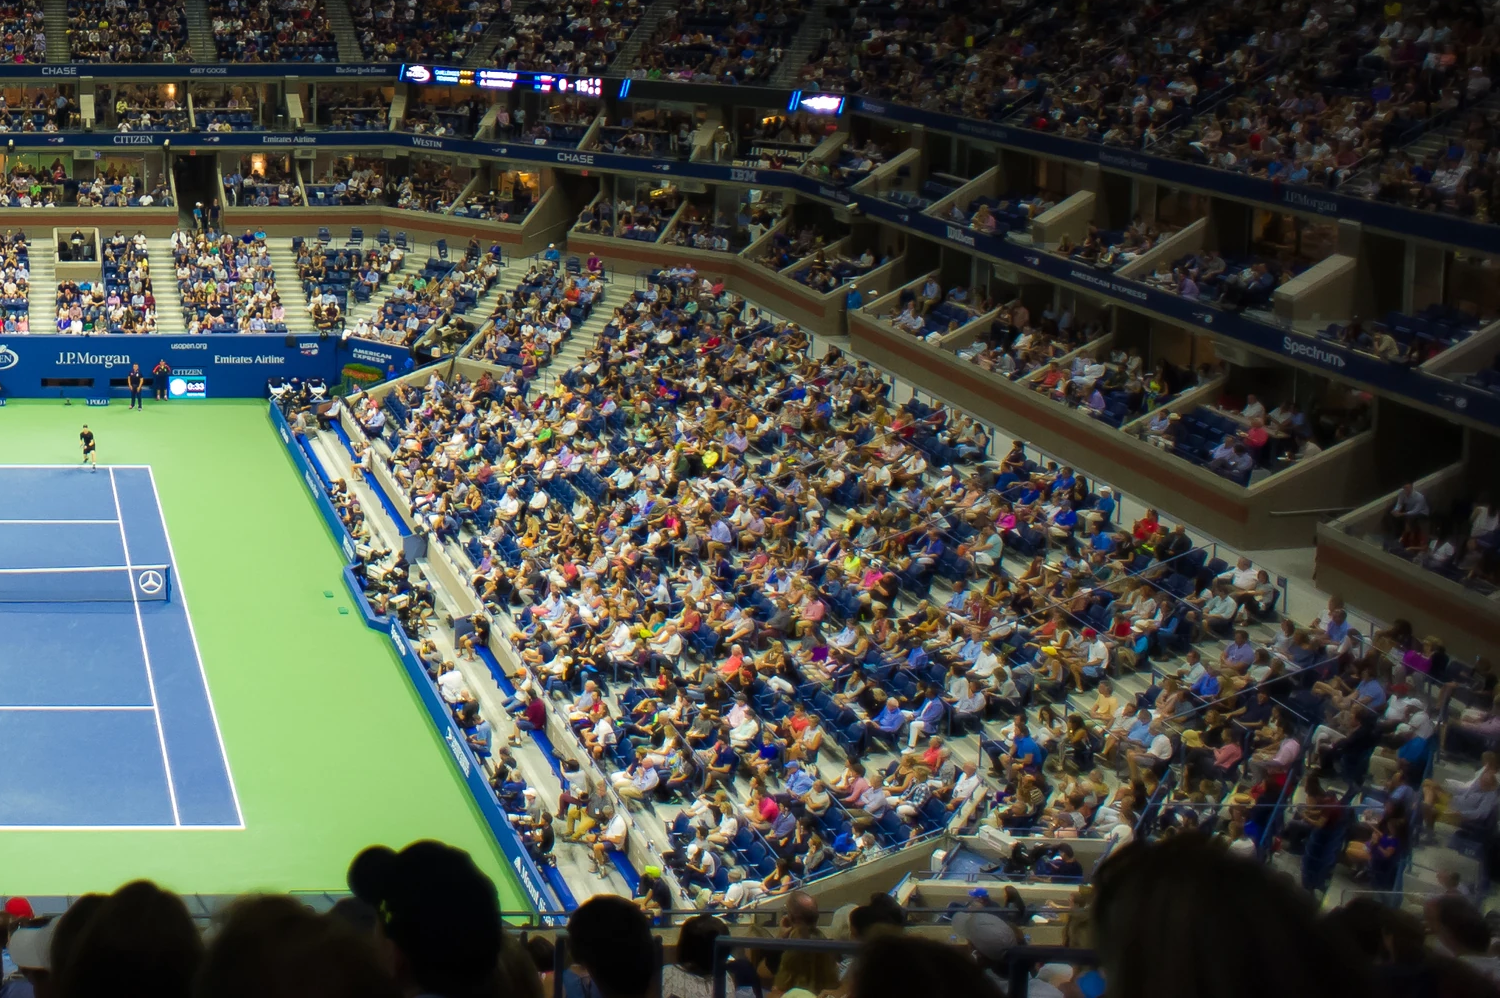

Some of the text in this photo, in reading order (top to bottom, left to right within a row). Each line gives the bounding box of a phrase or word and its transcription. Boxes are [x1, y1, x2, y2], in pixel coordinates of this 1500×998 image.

[41, 67, 77, 75] CHASE
[113, 135, 154, 144] CITIZEN
[412, 137, 443, 148] WESTIN
[556, 152, 594, 165] CHASE
[730, 168, 757, 182] IBM
[170, 343, 208, 351] usopen.org
[1283, 335, 1340, 365] Spectrum
[352, 347, 392, 360] AMERICAN
[352, 352, 386, 364] EXPRESS
[55, 351, 131, 369] J.P.Morgan
[214, 355, 285, 364] Emirates Airline
[172, 368, 203, 376] CITIZEN
